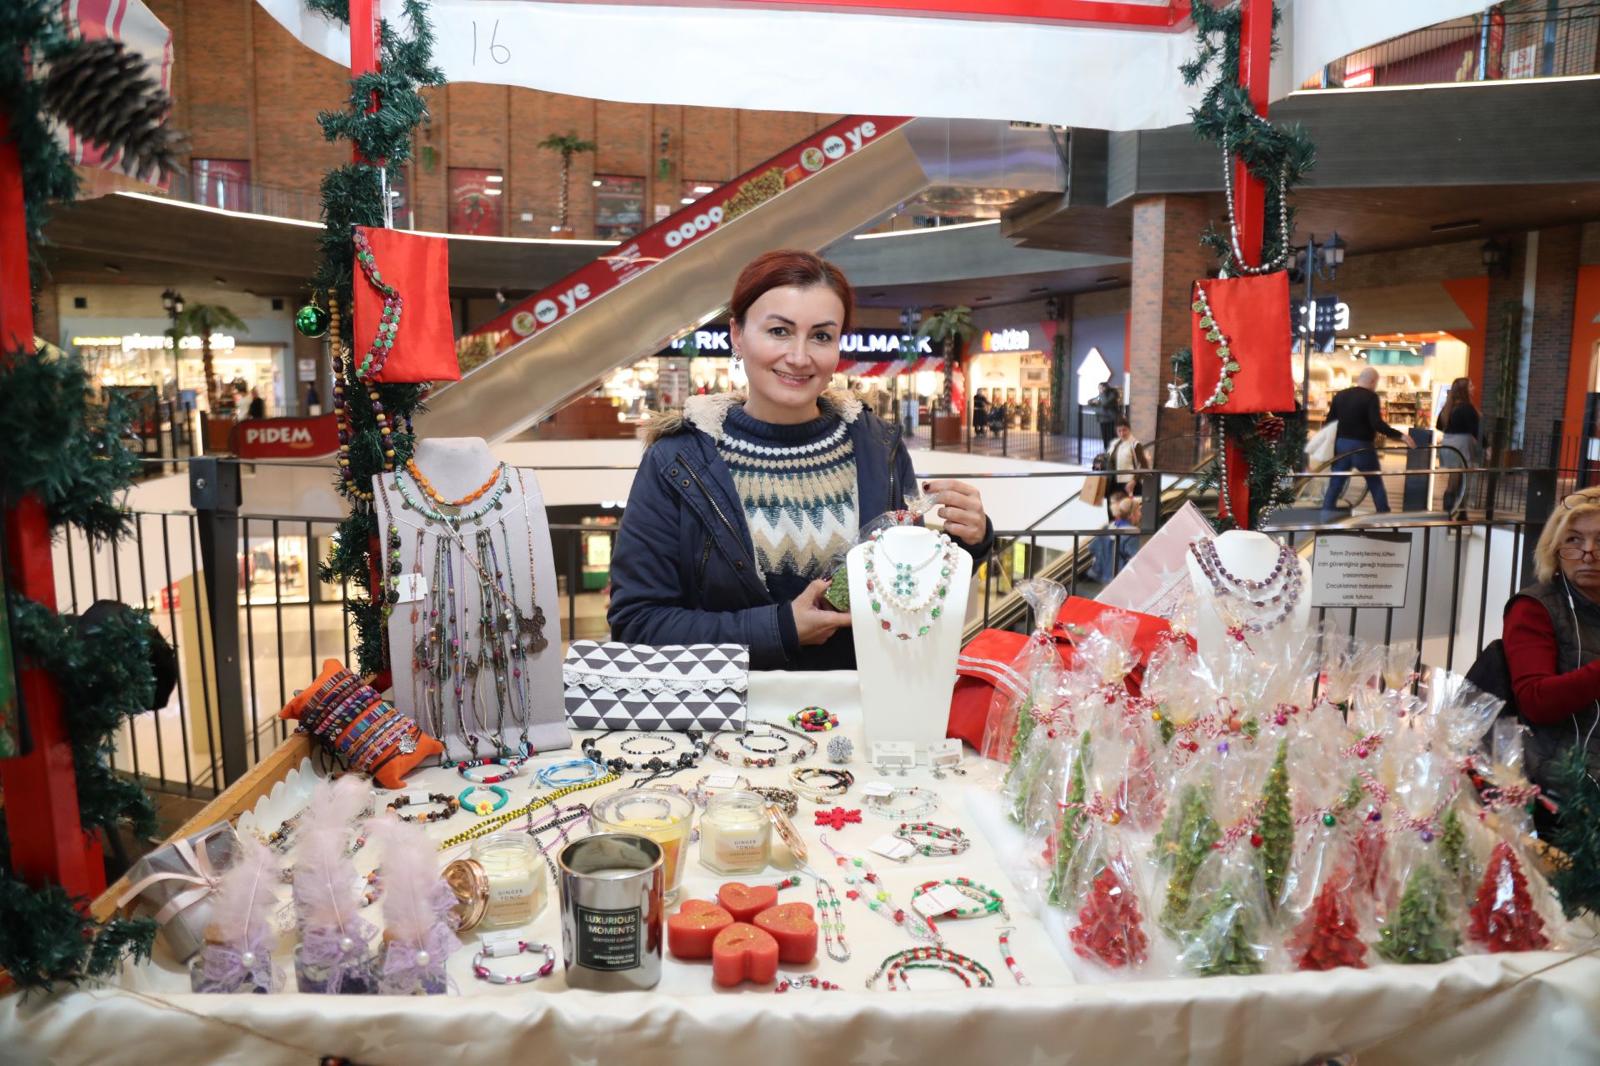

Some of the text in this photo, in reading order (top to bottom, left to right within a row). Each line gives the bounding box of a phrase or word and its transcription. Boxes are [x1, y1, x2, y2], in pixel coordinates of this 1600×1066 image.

[472, 19, 511, 66] 16
[844, 121, 877, 152] ye
[557, 283, 591, 315] ye
[584, 914, 636, 925] LUXURIOUS
[588, 925, 636, 935] MOMENTS
